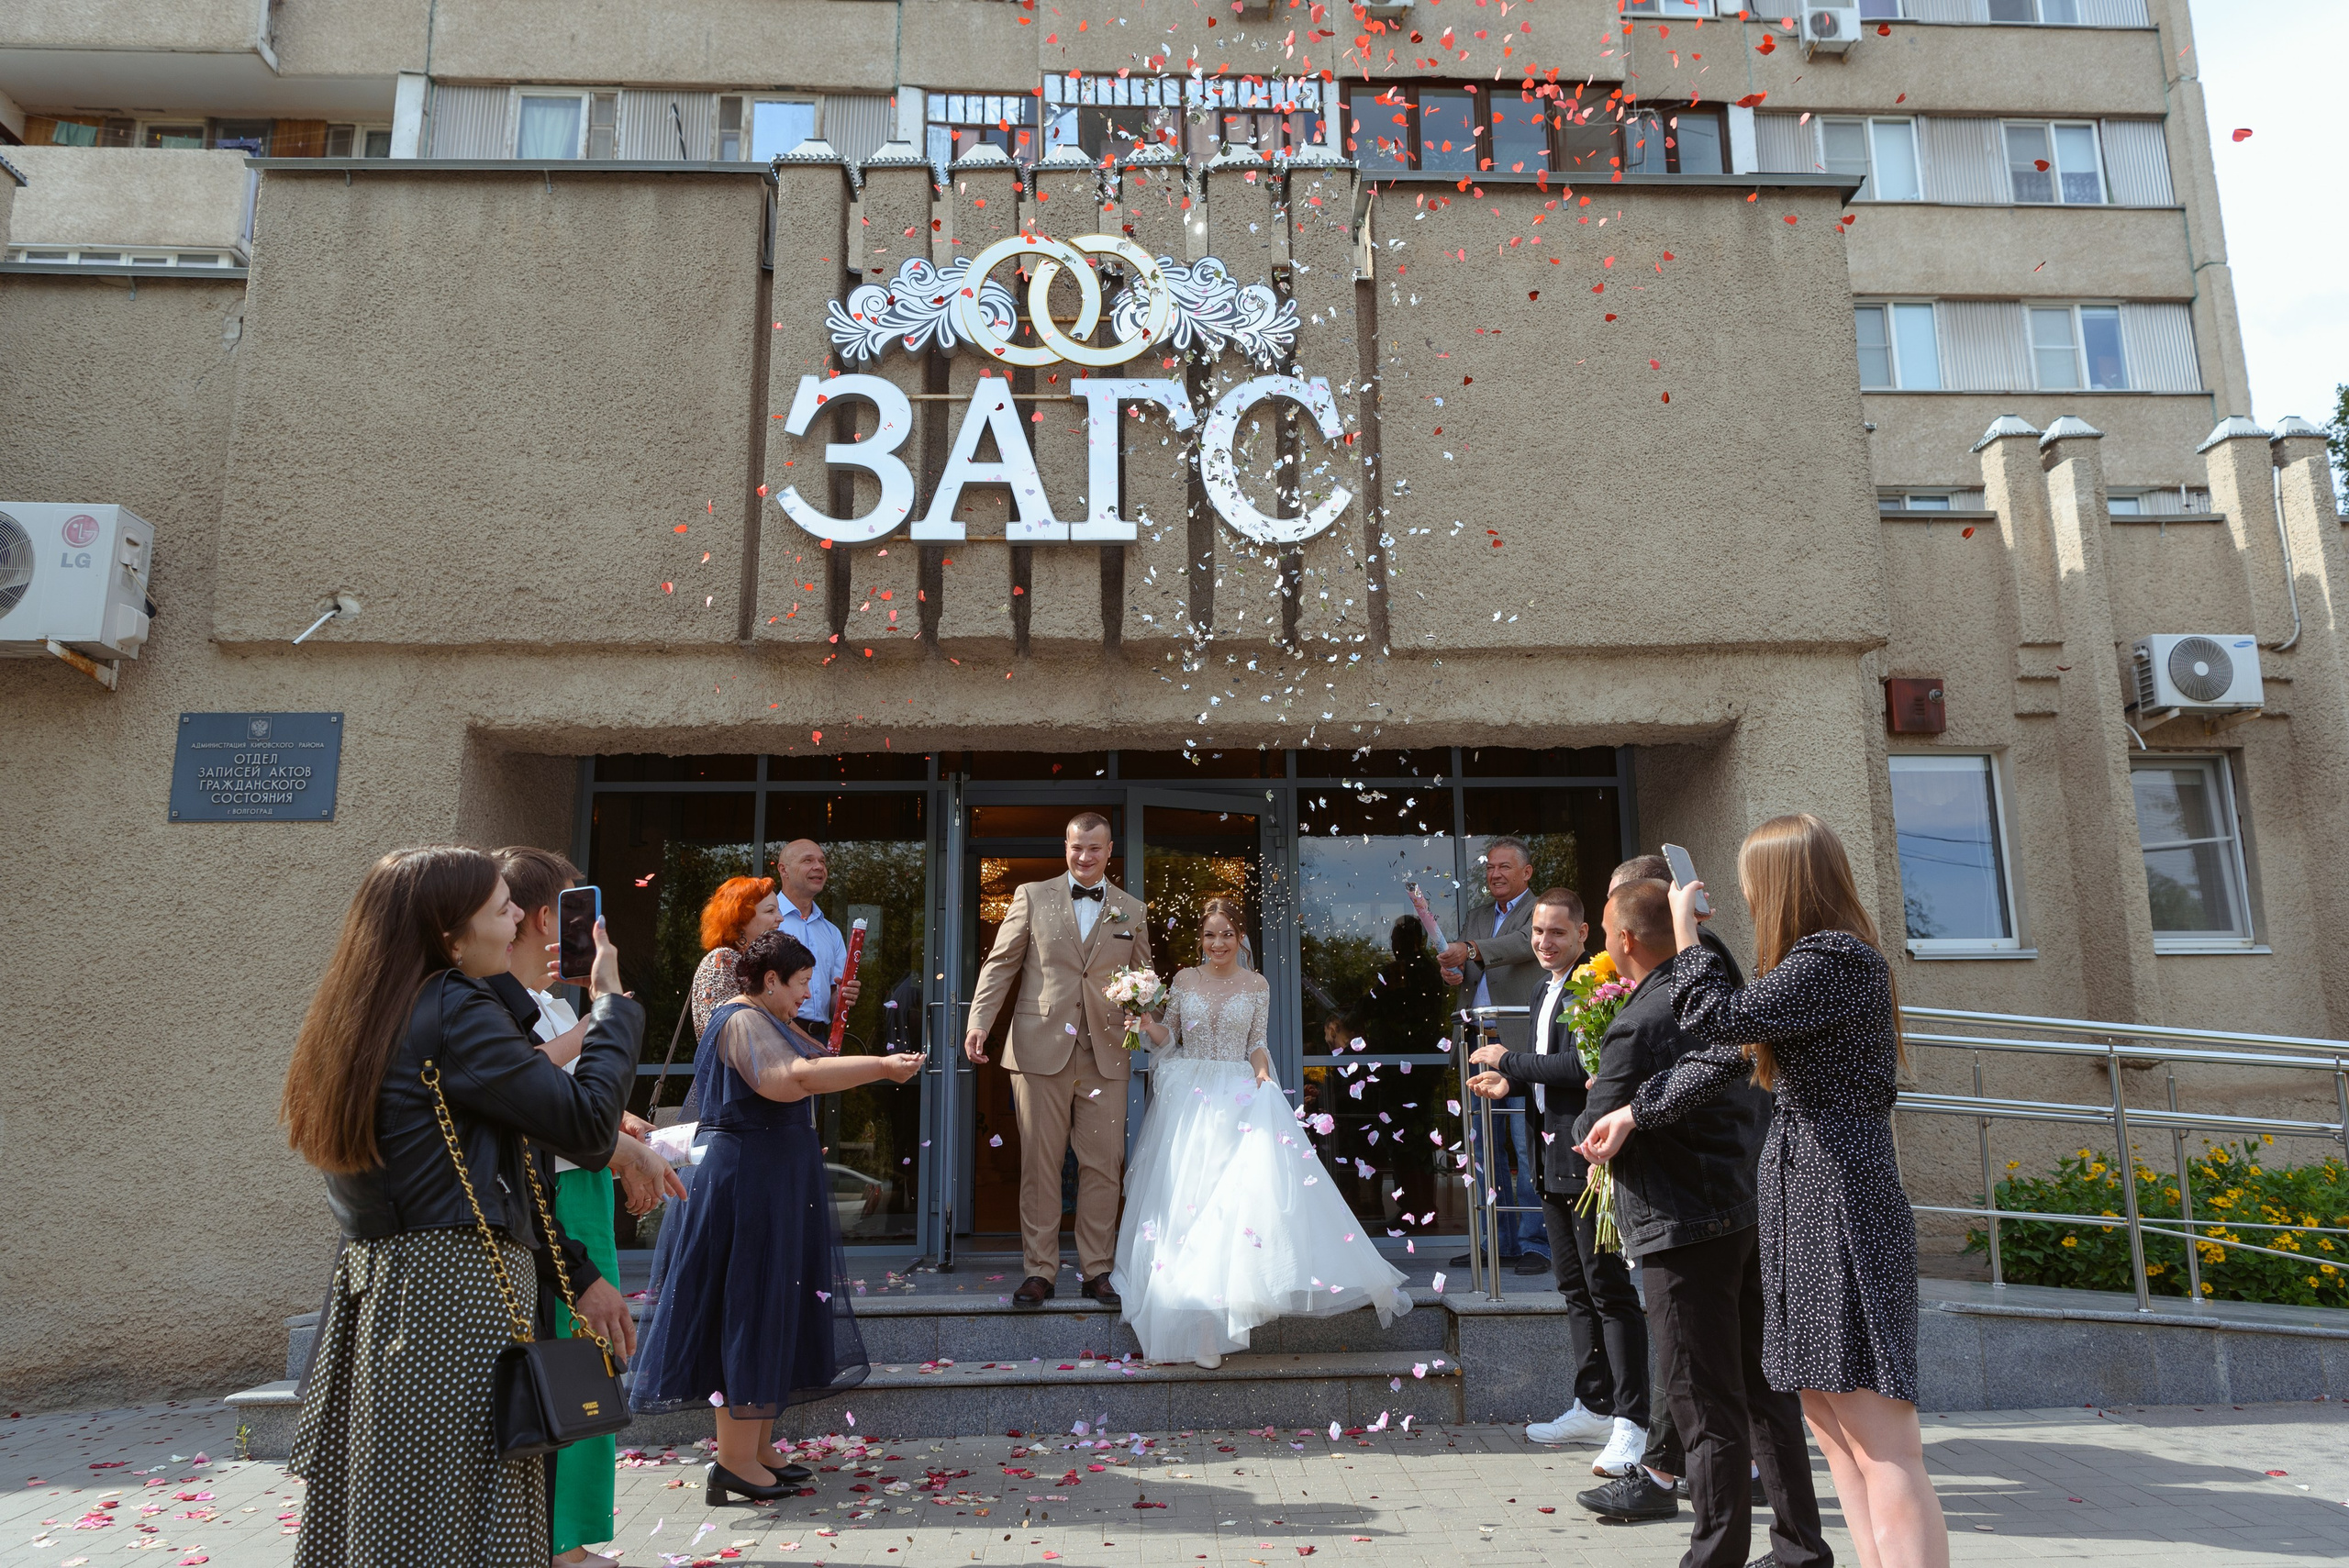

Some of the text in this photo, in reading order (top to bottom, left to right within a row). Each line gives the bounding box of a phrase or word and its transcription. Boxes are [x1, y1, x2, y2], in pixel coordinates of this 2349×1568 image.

[776, 374, 1353, 544] ЗАГС
[61, 552, 92, 569] LG
[191, 741, 247, 750] АДМИНИСТРАЦИЯ
[234, 753, 278, 765] ОТДЕЛ
[197, 765, 312, 778] ЗАПИСЕЙ АКТОВ
[199, 780, 306, 791] ГРАЖДАНСКОГО
[210, 793, 293, 804] СОСТОЯНИЯ
